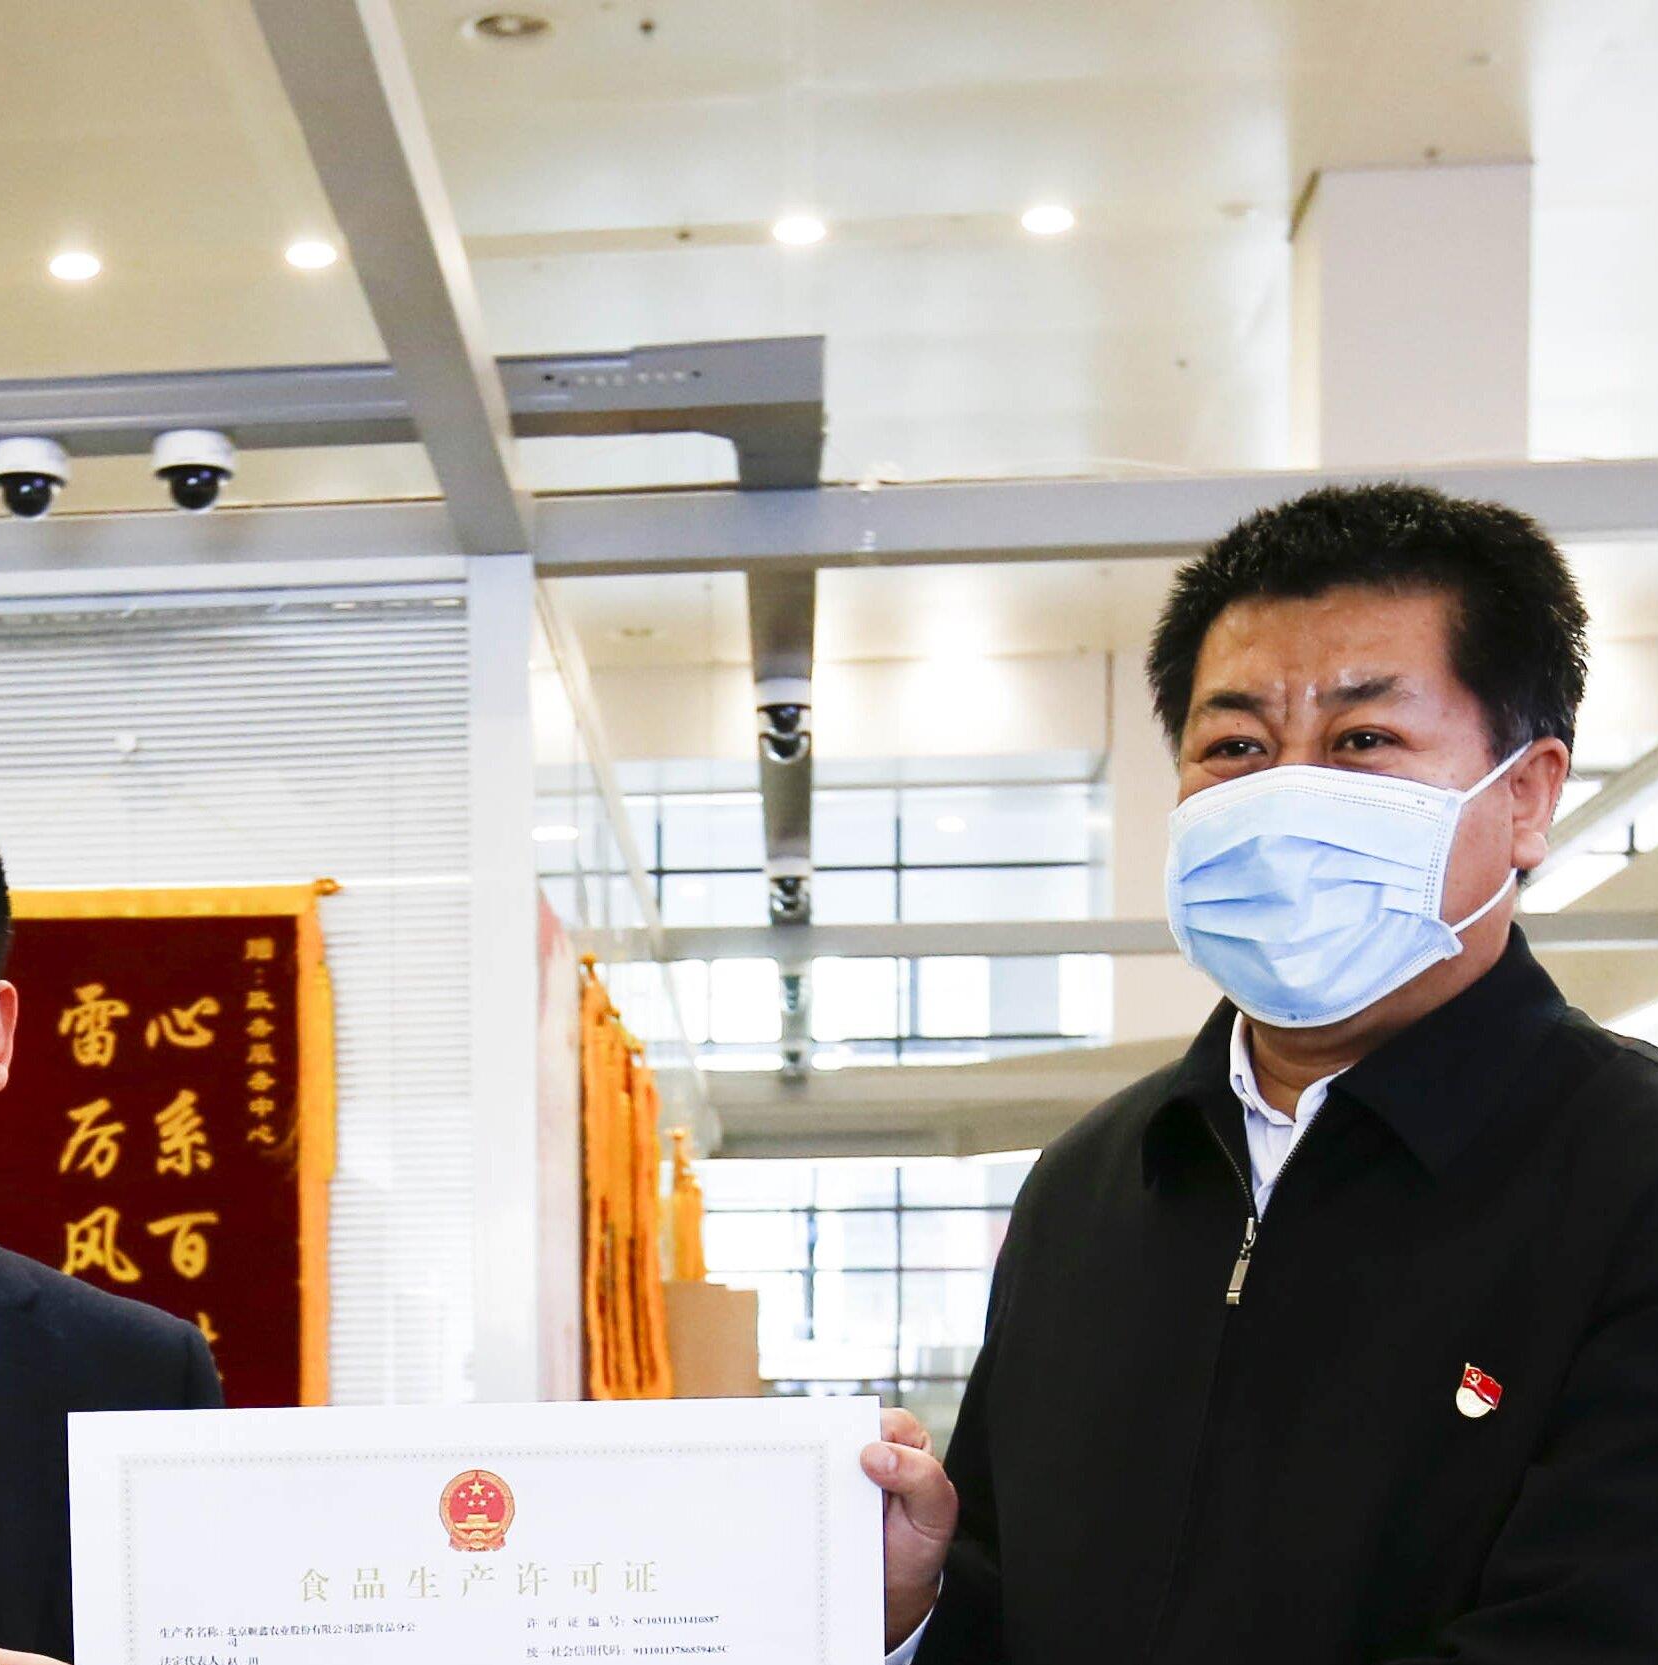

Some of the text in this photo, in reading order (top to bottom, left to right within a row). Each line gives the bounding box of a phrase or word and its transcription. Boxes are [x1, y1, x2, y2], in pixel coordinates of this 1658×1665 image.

[58, 983, 141, 1284] 雷厉风
[145, 995, 220, 1382] 心系百
[299, 1559, 660, 1602] 食品生产许可证
